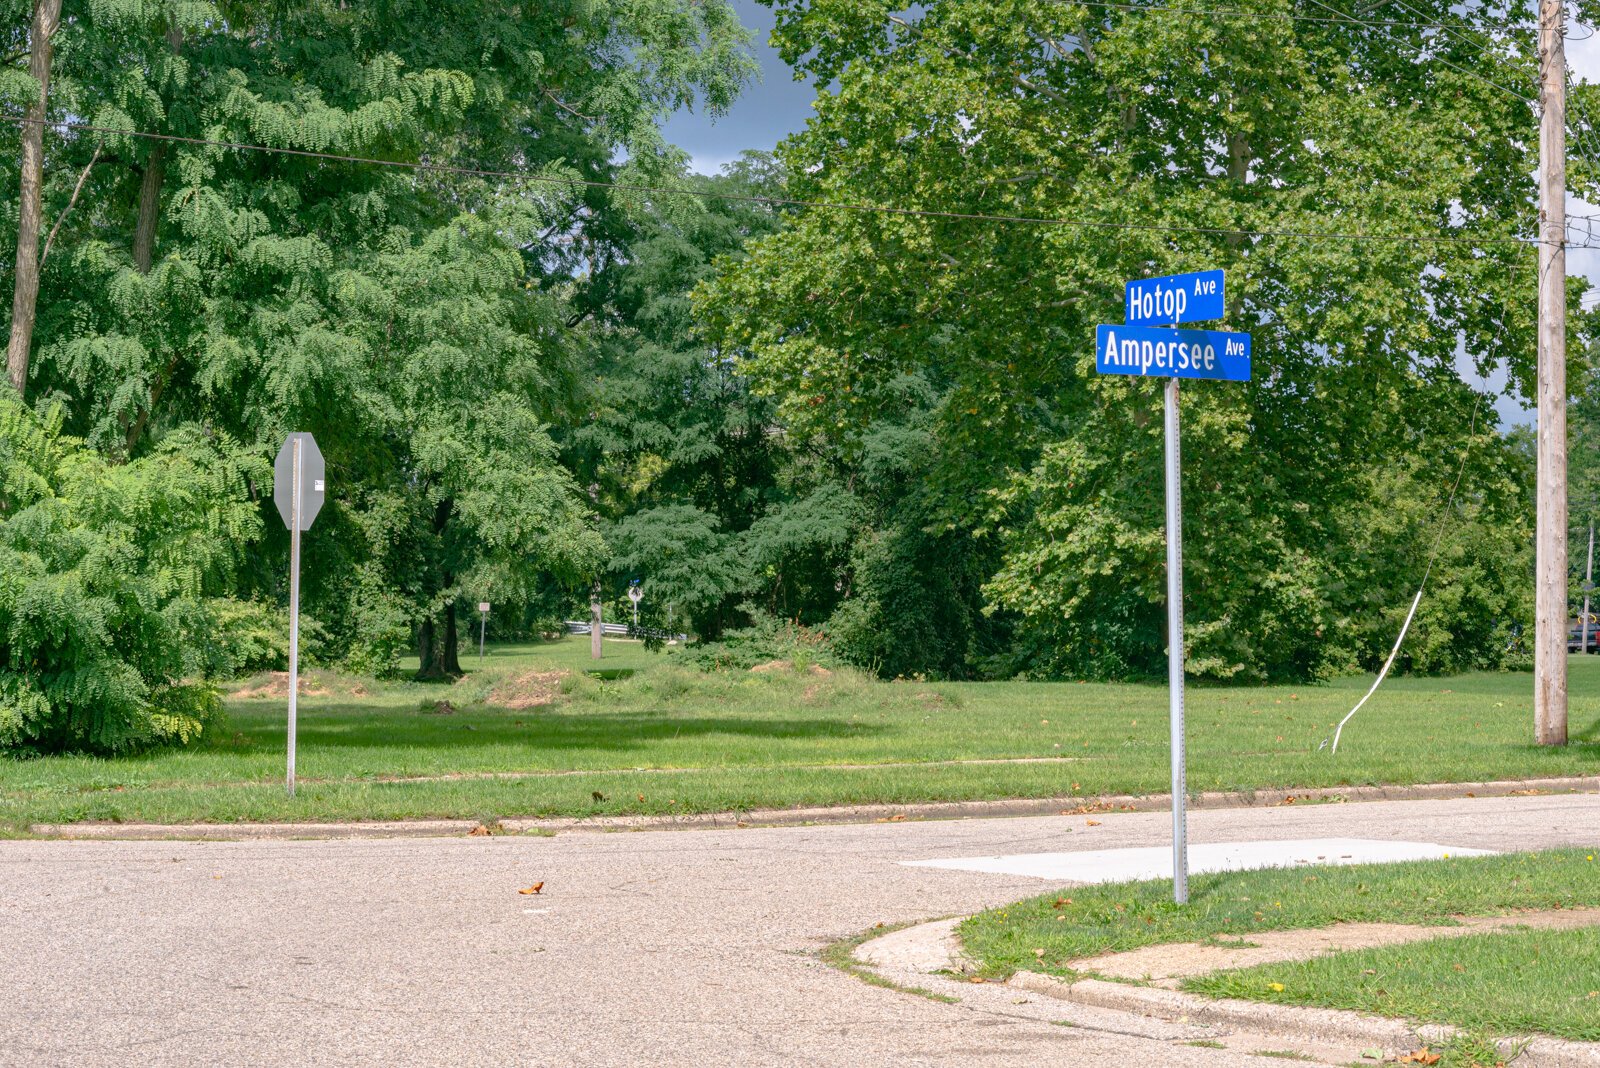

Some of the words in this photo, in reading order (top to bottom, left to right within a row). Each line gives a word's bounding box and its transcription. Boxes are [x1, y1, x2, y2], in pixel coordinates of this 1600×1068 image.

[1130, 284, 1187, 323] Hotop
[1194, 278, 1216, 296] Ave
[1104, 331, 1215, 375] Ampersee
[1225, 338, 1245, 356] Ave
